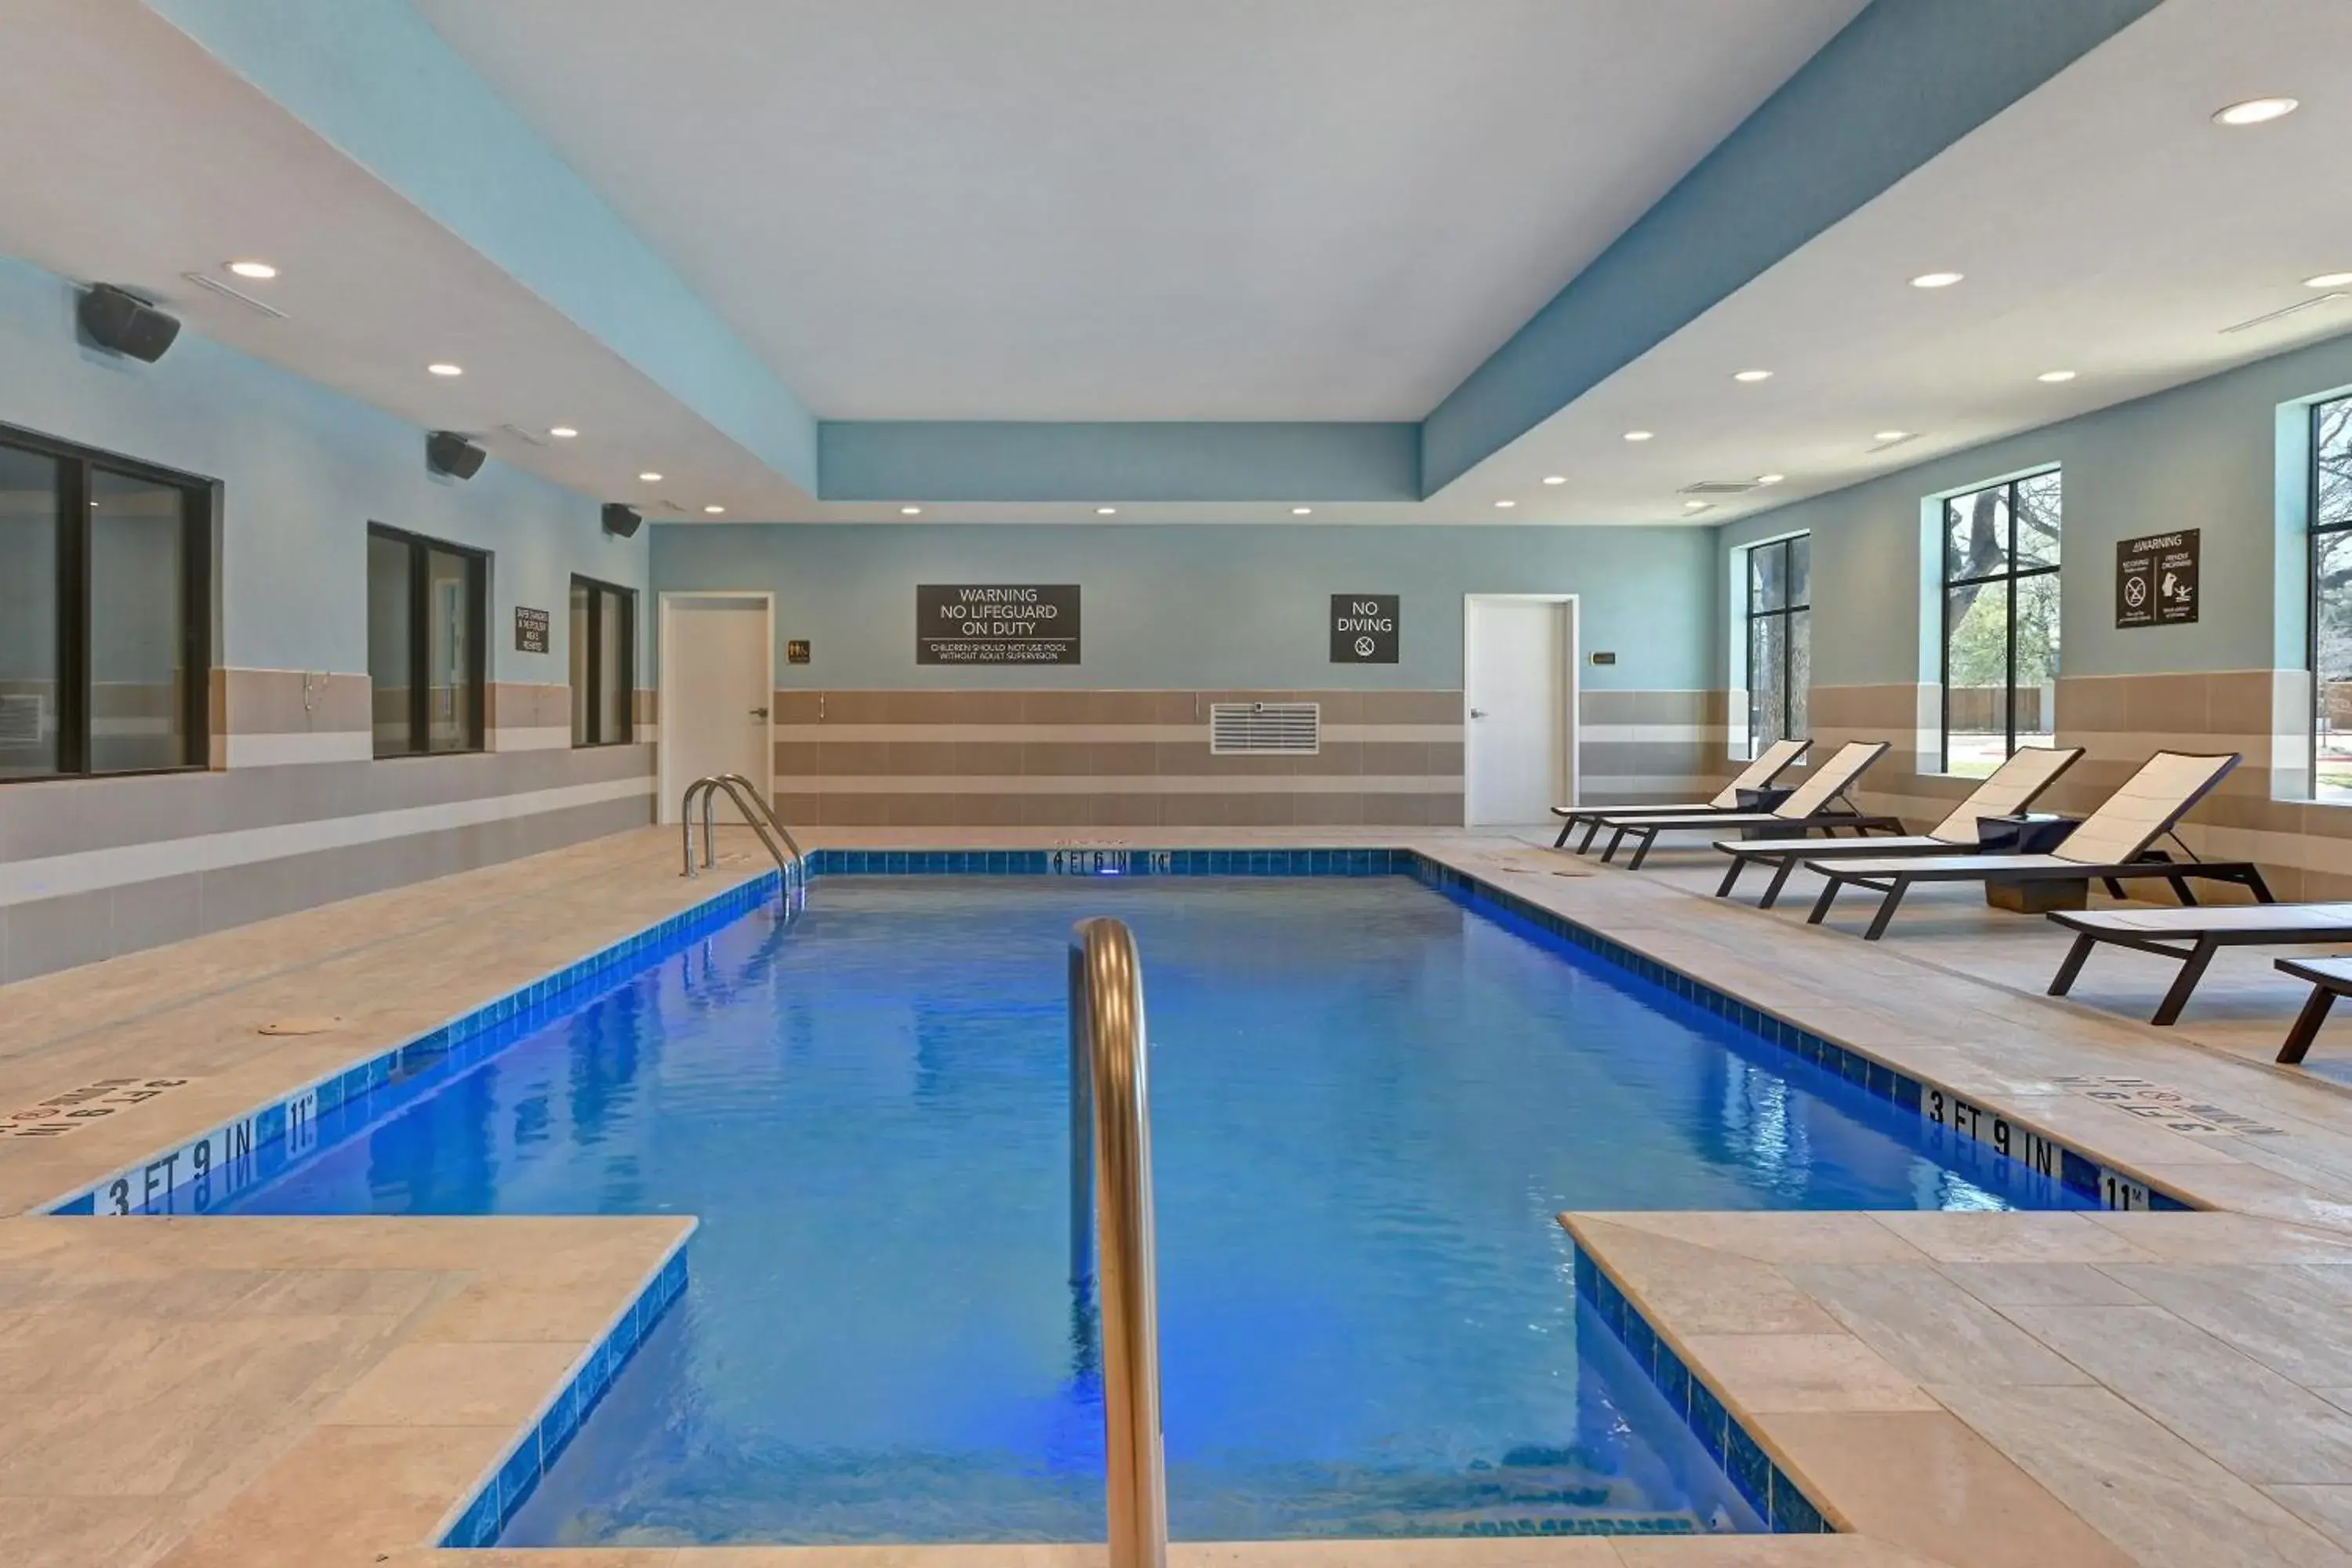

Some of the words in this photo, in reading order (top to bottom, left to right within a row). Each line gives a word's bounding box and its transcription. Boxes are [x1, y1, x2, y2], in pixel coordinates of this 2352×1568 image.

[2139, 535, 2182, 551] WARNING
[959, 589, 1037, 602] WARNING
[941, 604, 967, 619] NO
[971, 604, 1058, 619] LIFEGUARD
[1352, 601, 1377, 615] NO
[962, 622, 987, 636] ON
[993, 622, 1036, 635] DUTY
[1338, 618, 1392, 632] DIVING
[1929, 1090, 1944, 1124] 3
[1955, 1099, 1982, 1142] FT
[1994, 1119, 2010, 1156] 9
[2025, 1131, 2052, 1178] IN
[109, 1178, 129, 1215] 3
[145, 1152, 180, 1205] FT
[194, 1139, 211, 1180] 9
[225, 1119, 250, 1165] IN
